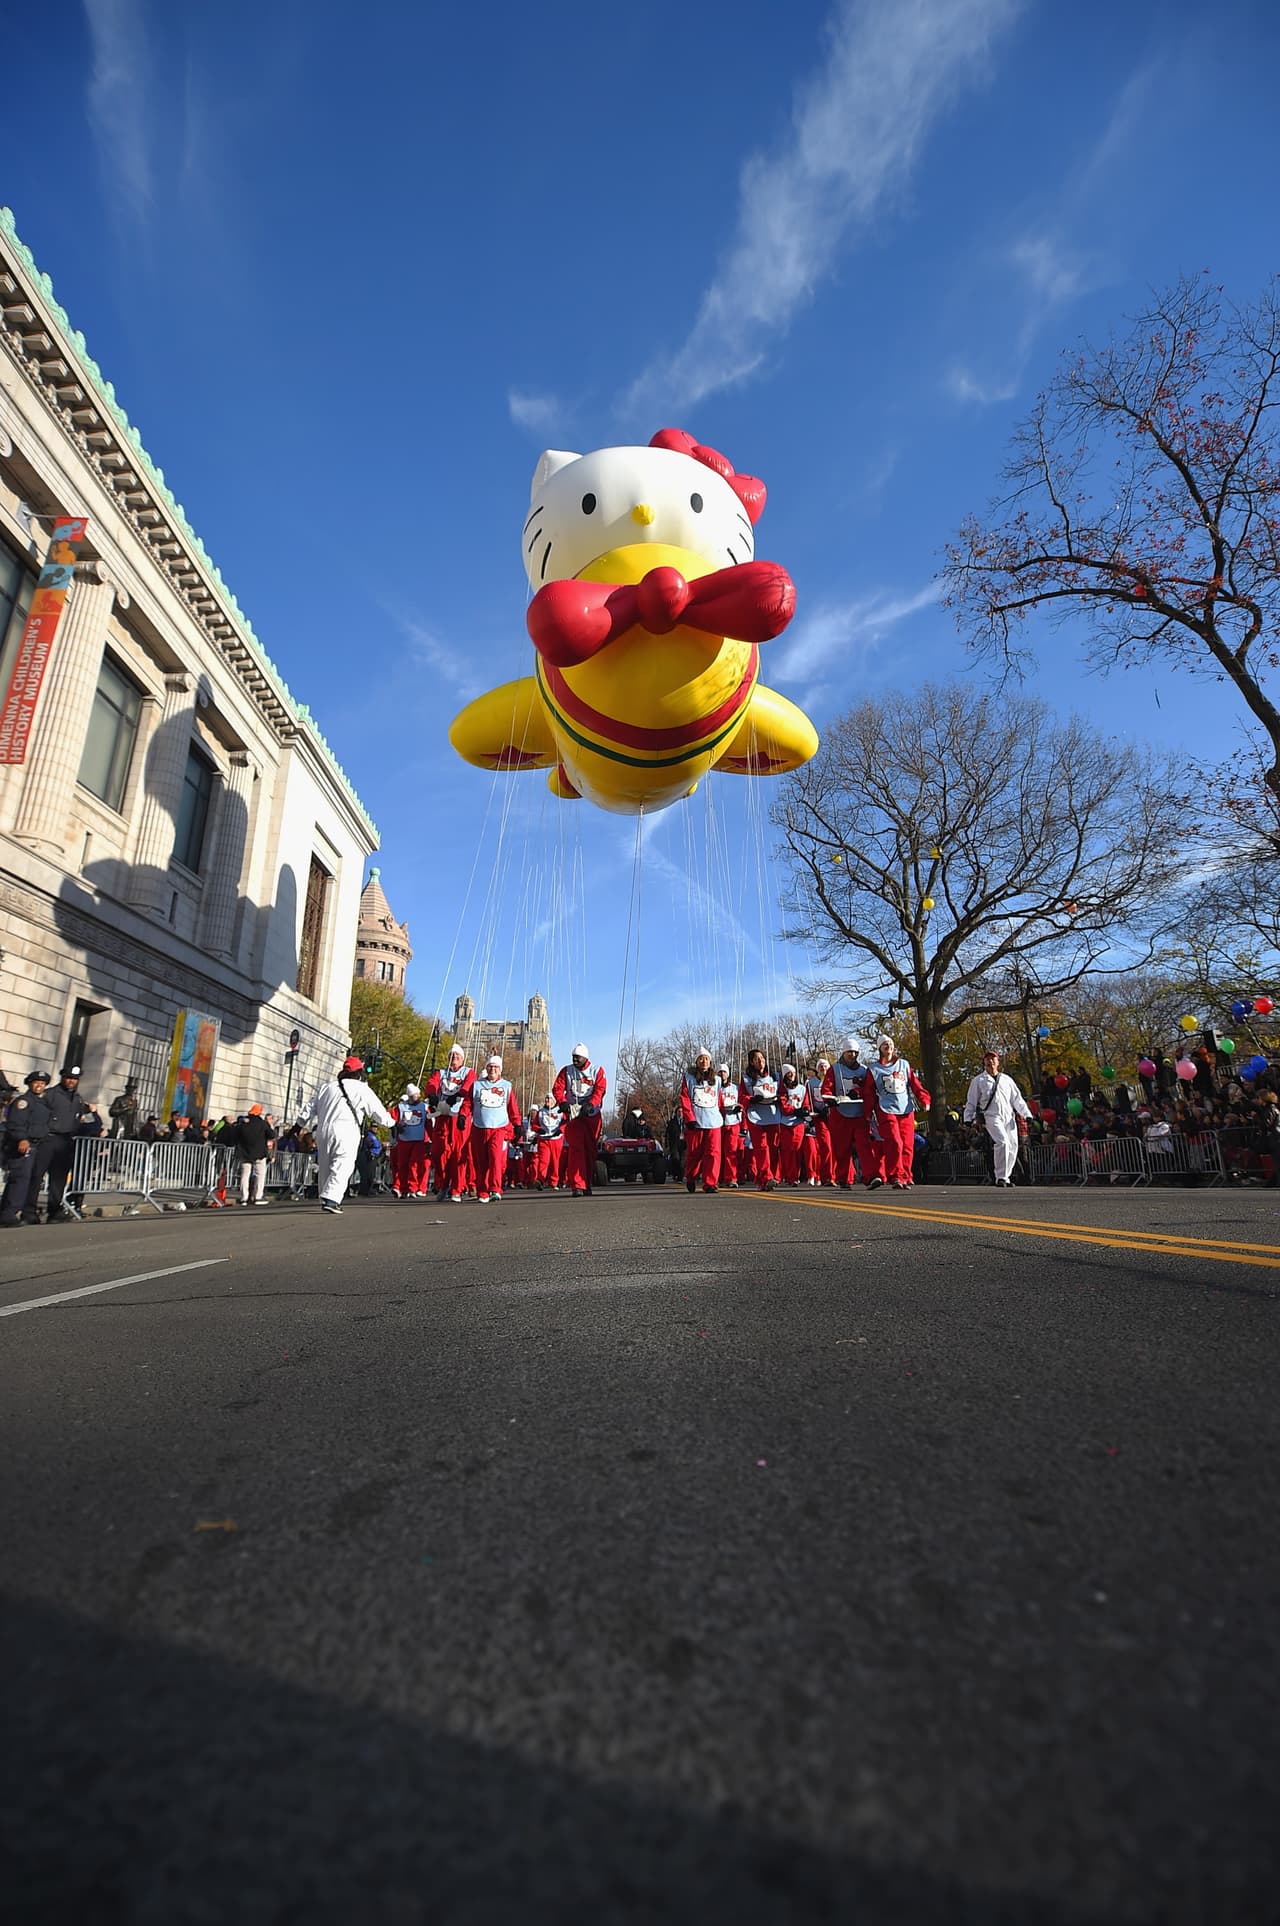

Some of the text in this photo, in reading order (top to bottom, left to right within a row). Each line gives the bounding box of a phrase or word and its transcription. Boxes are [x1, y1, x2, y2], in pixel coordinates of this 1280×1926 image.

[0, 618, 42, 761] DIMENNA CHILDREN'S
[10, 642, 49, 761] HISTORY MUSEUM
